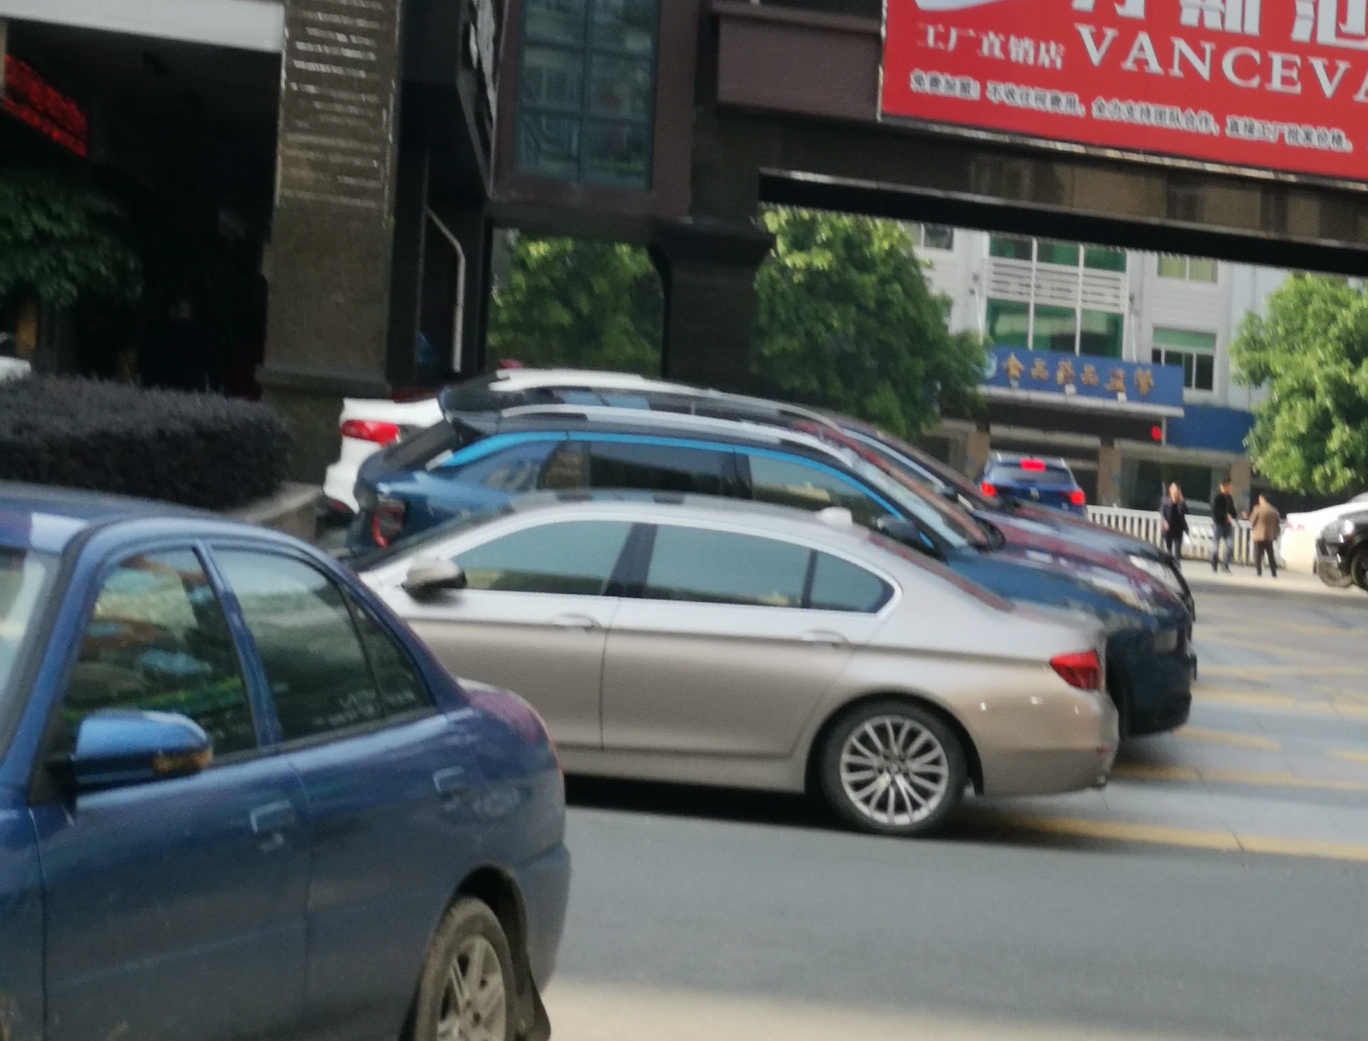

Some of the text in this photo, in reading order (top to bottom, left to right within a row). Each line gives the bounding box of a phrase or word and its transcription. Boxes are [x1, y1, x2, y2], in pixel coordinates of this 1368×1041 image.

[916, 21, 1066, 71] 工厂直销店
